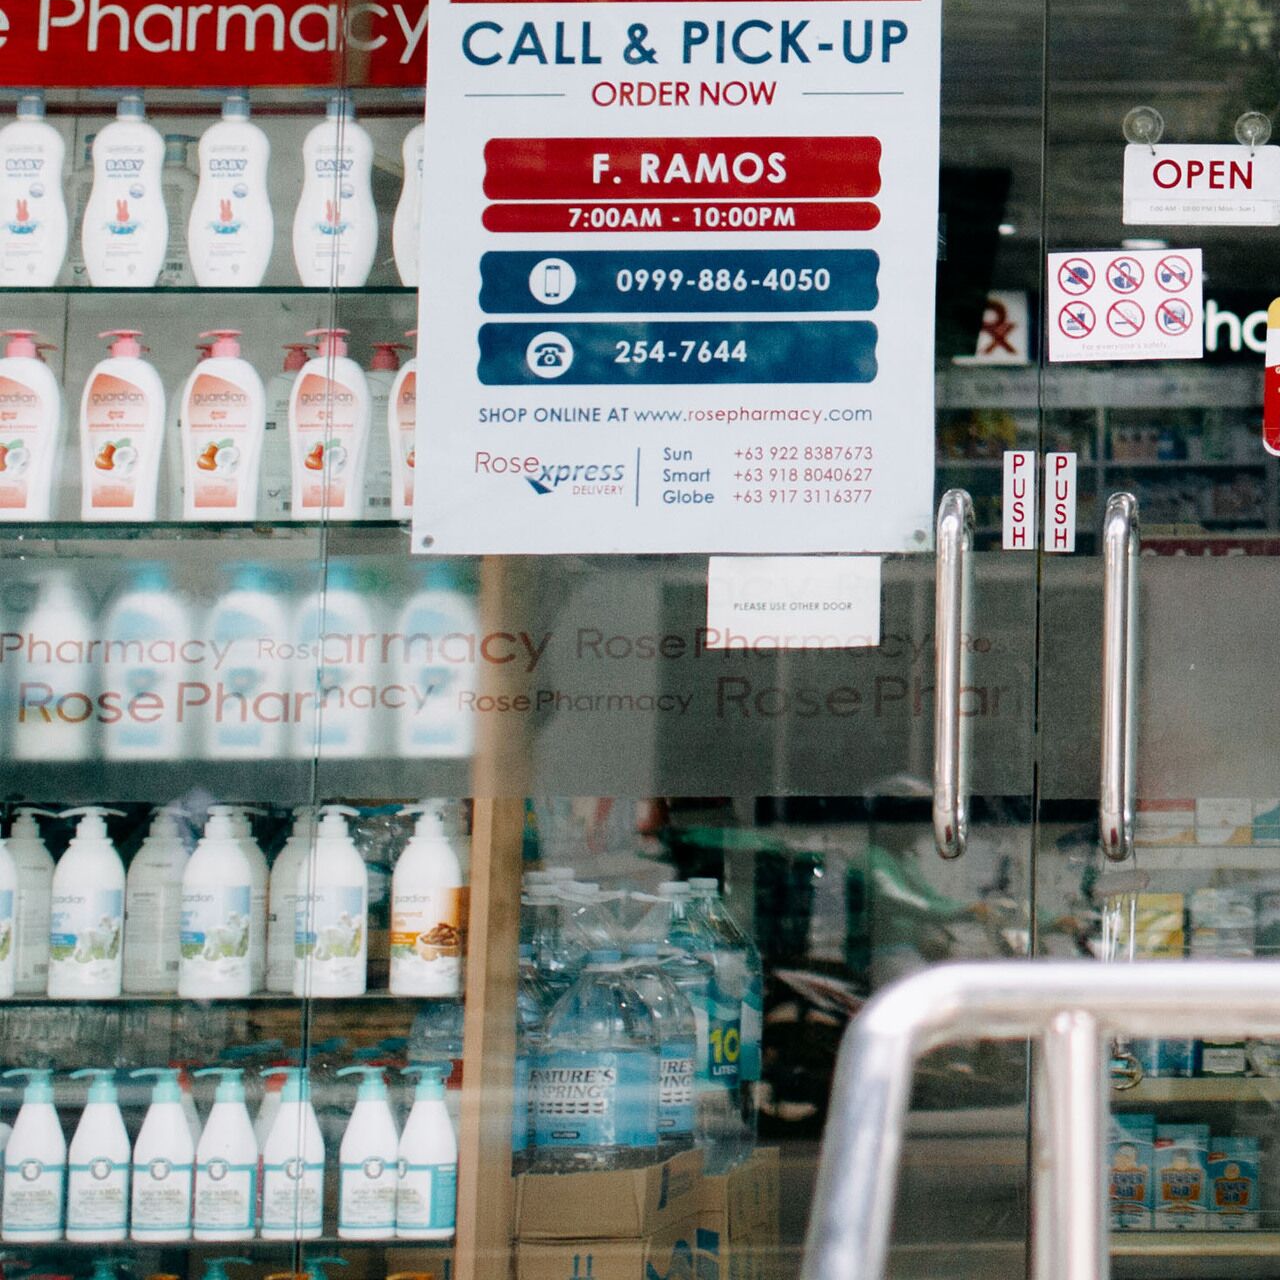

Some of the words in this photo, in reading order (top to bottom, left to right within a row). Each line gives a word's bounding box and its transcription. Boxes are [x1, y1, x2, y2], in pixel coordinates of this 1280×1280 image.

[461, 21, 602, 66] CALL
[622, 22, 659, 65] &
[682, 19, 908, 64] PICK-UP
[591, 81, 691, 107] ORDER
[699, 80, 777, 106] NOW
[592, 154, 621, 184] F.
[639, 152, 788, 184] RAMOS
[1152, 158, 1254, 190] OPEN
[568, 208, 662, 228] 7:00AM
[691, 207, 797, 228] 10:00PM
[616, 269, 831, 292] 0999-886-4050
[614, 340, 747, 363] 254-7644
[478, 407, 528, 424] SHOP
[533, 407, 602, 423] ONLINE
[606, 407, 629, 423] AT
[633, 405, 874, 425] www.rosepharmacy.com
[662, 446, 693, 461] Sun
[733, 447, 764, 461] +63
[769, 447, 799, 460] 922
[803, 446, 873, 460] 8387673
[662, 467, 711, 482] Smart
[733, 468, 764, 482] +63
[769, 468, 799, 482] 918
[803, 467, 873, 482] 8040627
[571, 485, 625, 496] DELIVERY
[662, 488, 715, 504] Globe
[733, 489, 764, 504] +63
[768, 489, 798, 503] 917
[803, 489, 872, 503] 3116377
[1012, 454, 1026, 547] PUSH
[1054, 456, 1068, 549] PUSH
[733, 602, 768, 611] PLEASE
[770, 602, 788, 611] USE
[789, 602, 818, 611] OTHER
[821, 601, 853, 611] DOOR
[0, 631, 234, 671] Pharmacy
[576, 627, 688, 661] Rose
[18, 681, 165, 724] Rose
[458, 689, 530, 713] Rose
[535, 688, 694, 718] Pharmacy
[709, 1027, 741, 1064] 10
